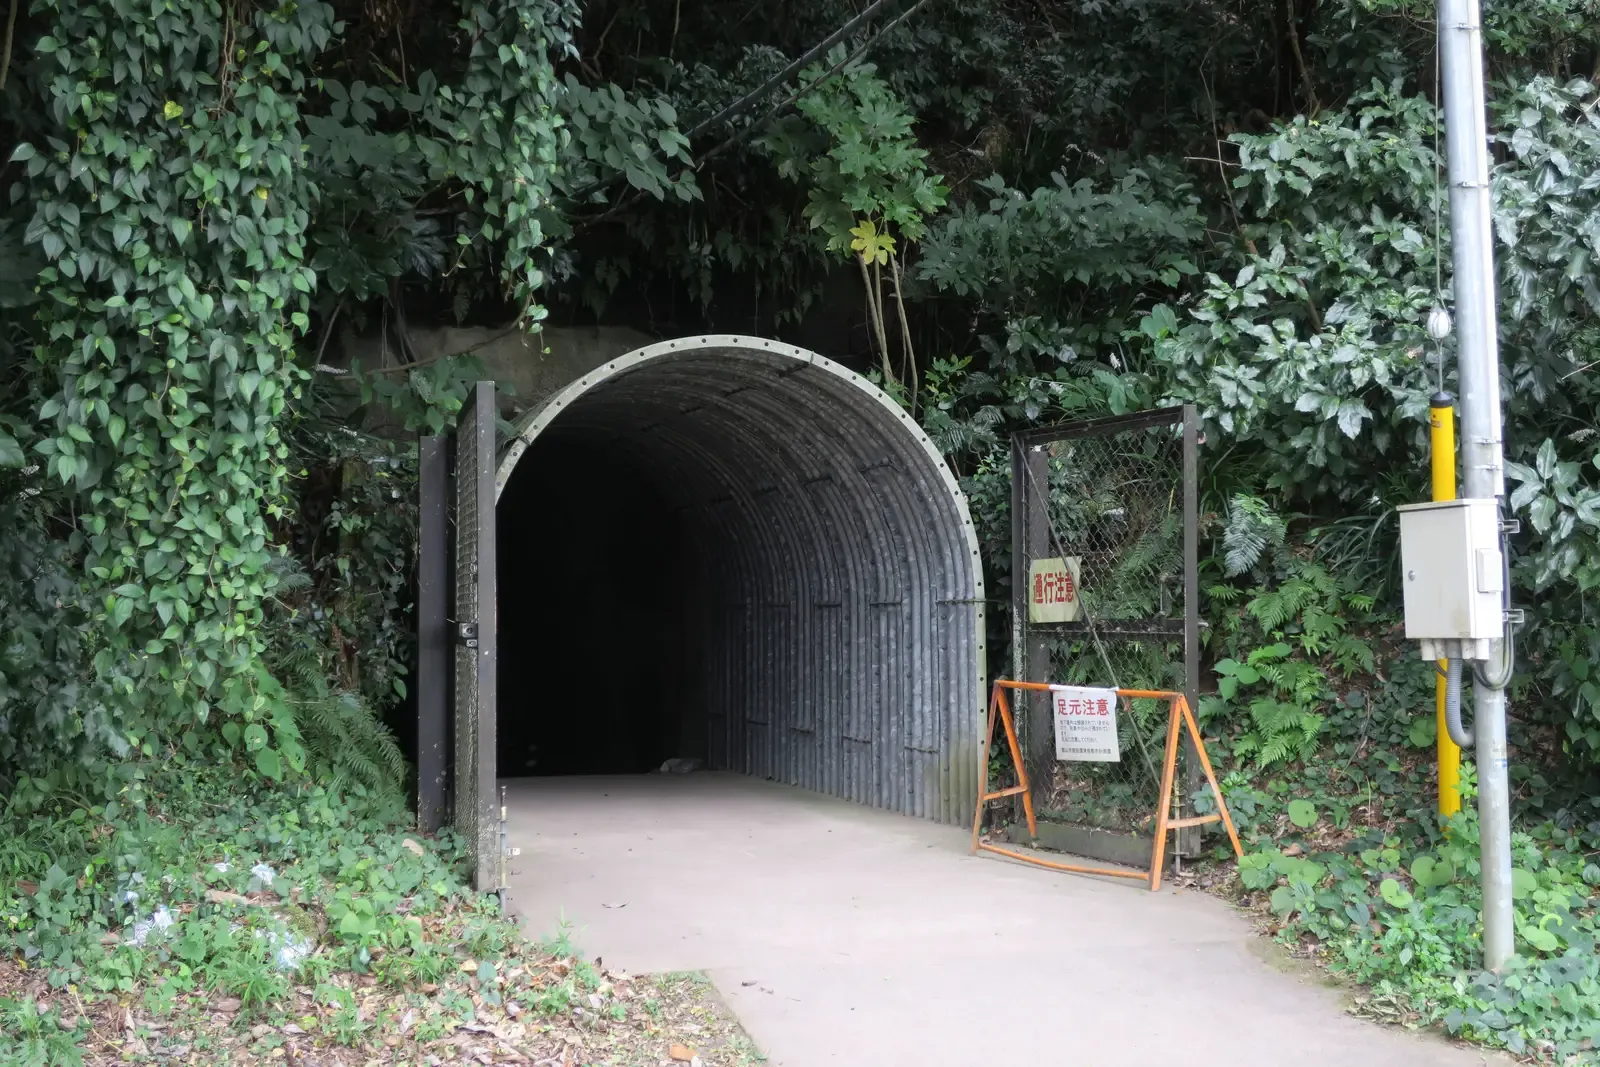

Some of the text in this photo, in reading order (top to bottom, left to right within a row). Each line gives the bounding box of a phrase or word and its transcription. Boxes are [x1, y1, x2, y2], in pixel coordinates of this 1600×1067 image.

[1033, 572, 1074, 604] 通行注意
[1057, 699, 1110, 716] 足元注意
